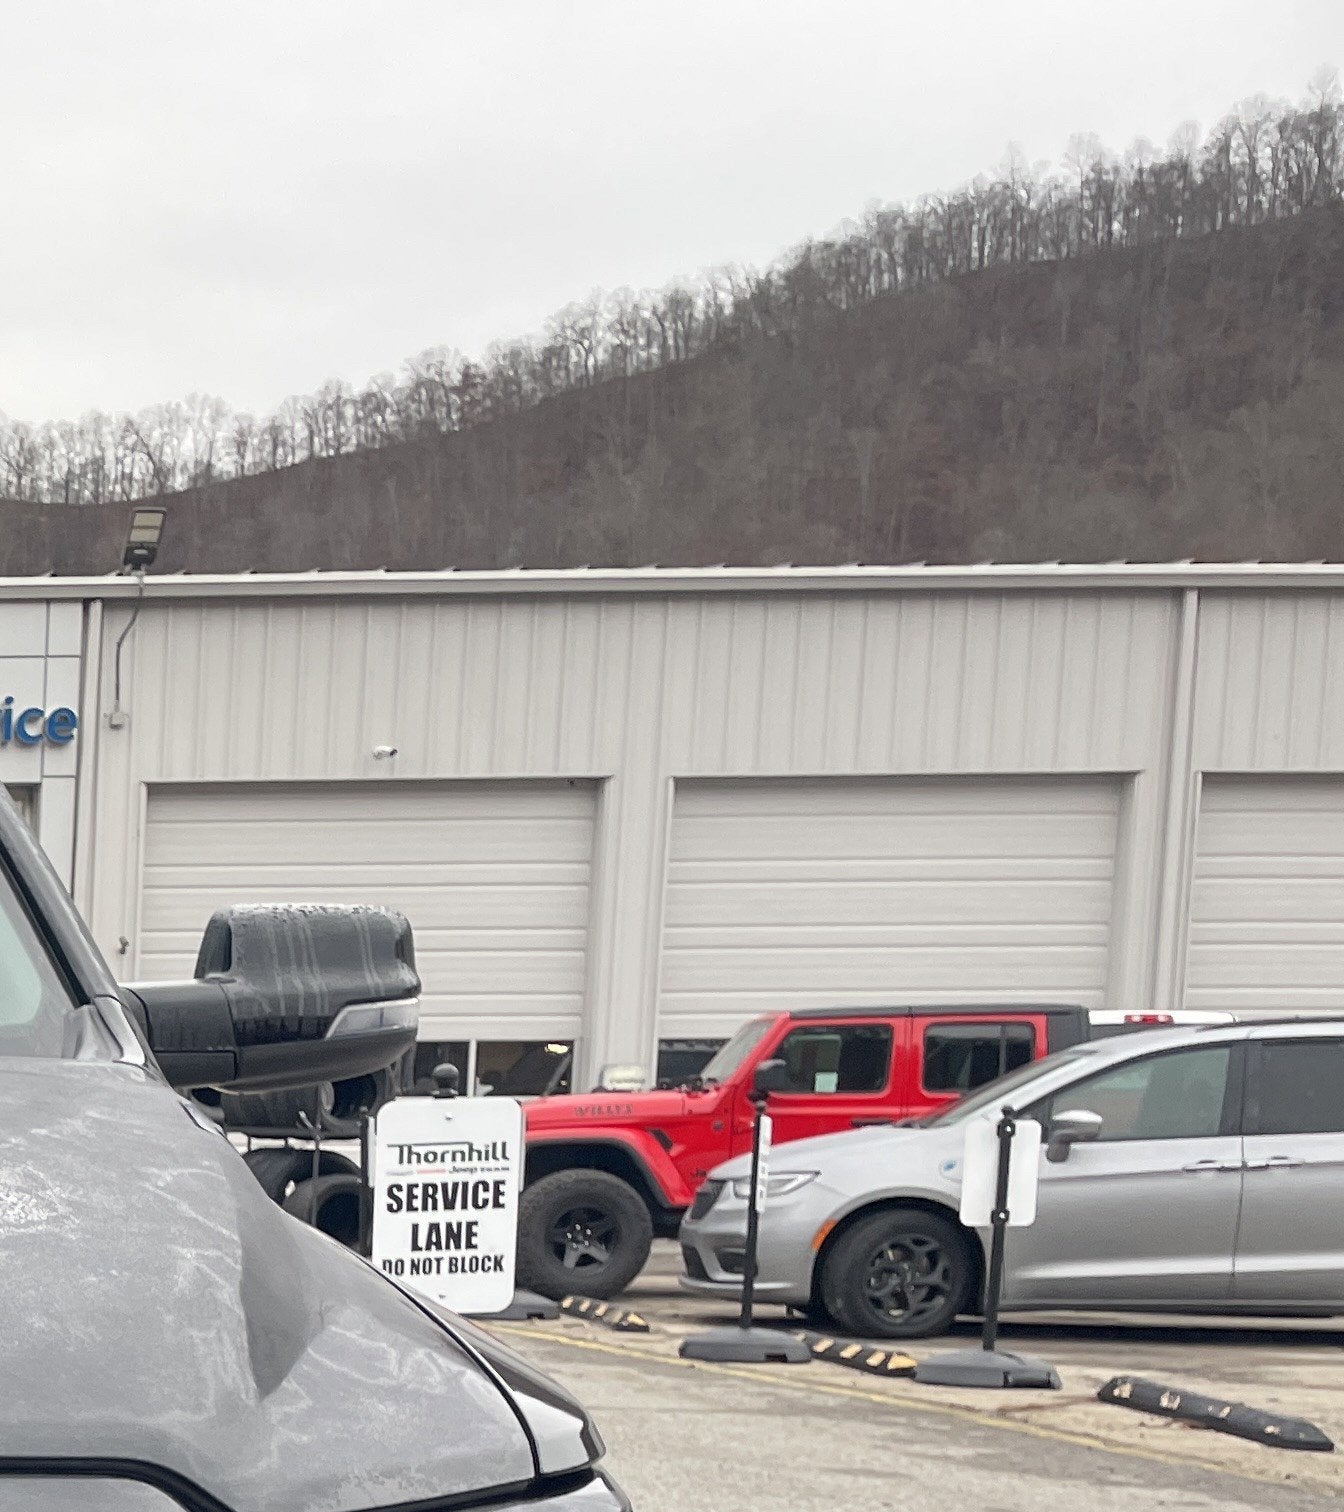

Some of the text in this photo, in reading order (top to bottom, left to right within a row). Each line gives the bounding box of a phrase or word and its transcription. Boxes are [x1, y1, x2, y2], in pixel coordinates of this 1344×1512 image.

[387, 1141, 510, 1165] Thornhill
[386, 1179, 507, 1214] SERVICE
[410, 1220, 480, 1252] LANE
[382, 1253, 505, 1277] DO NOT BLOCK
